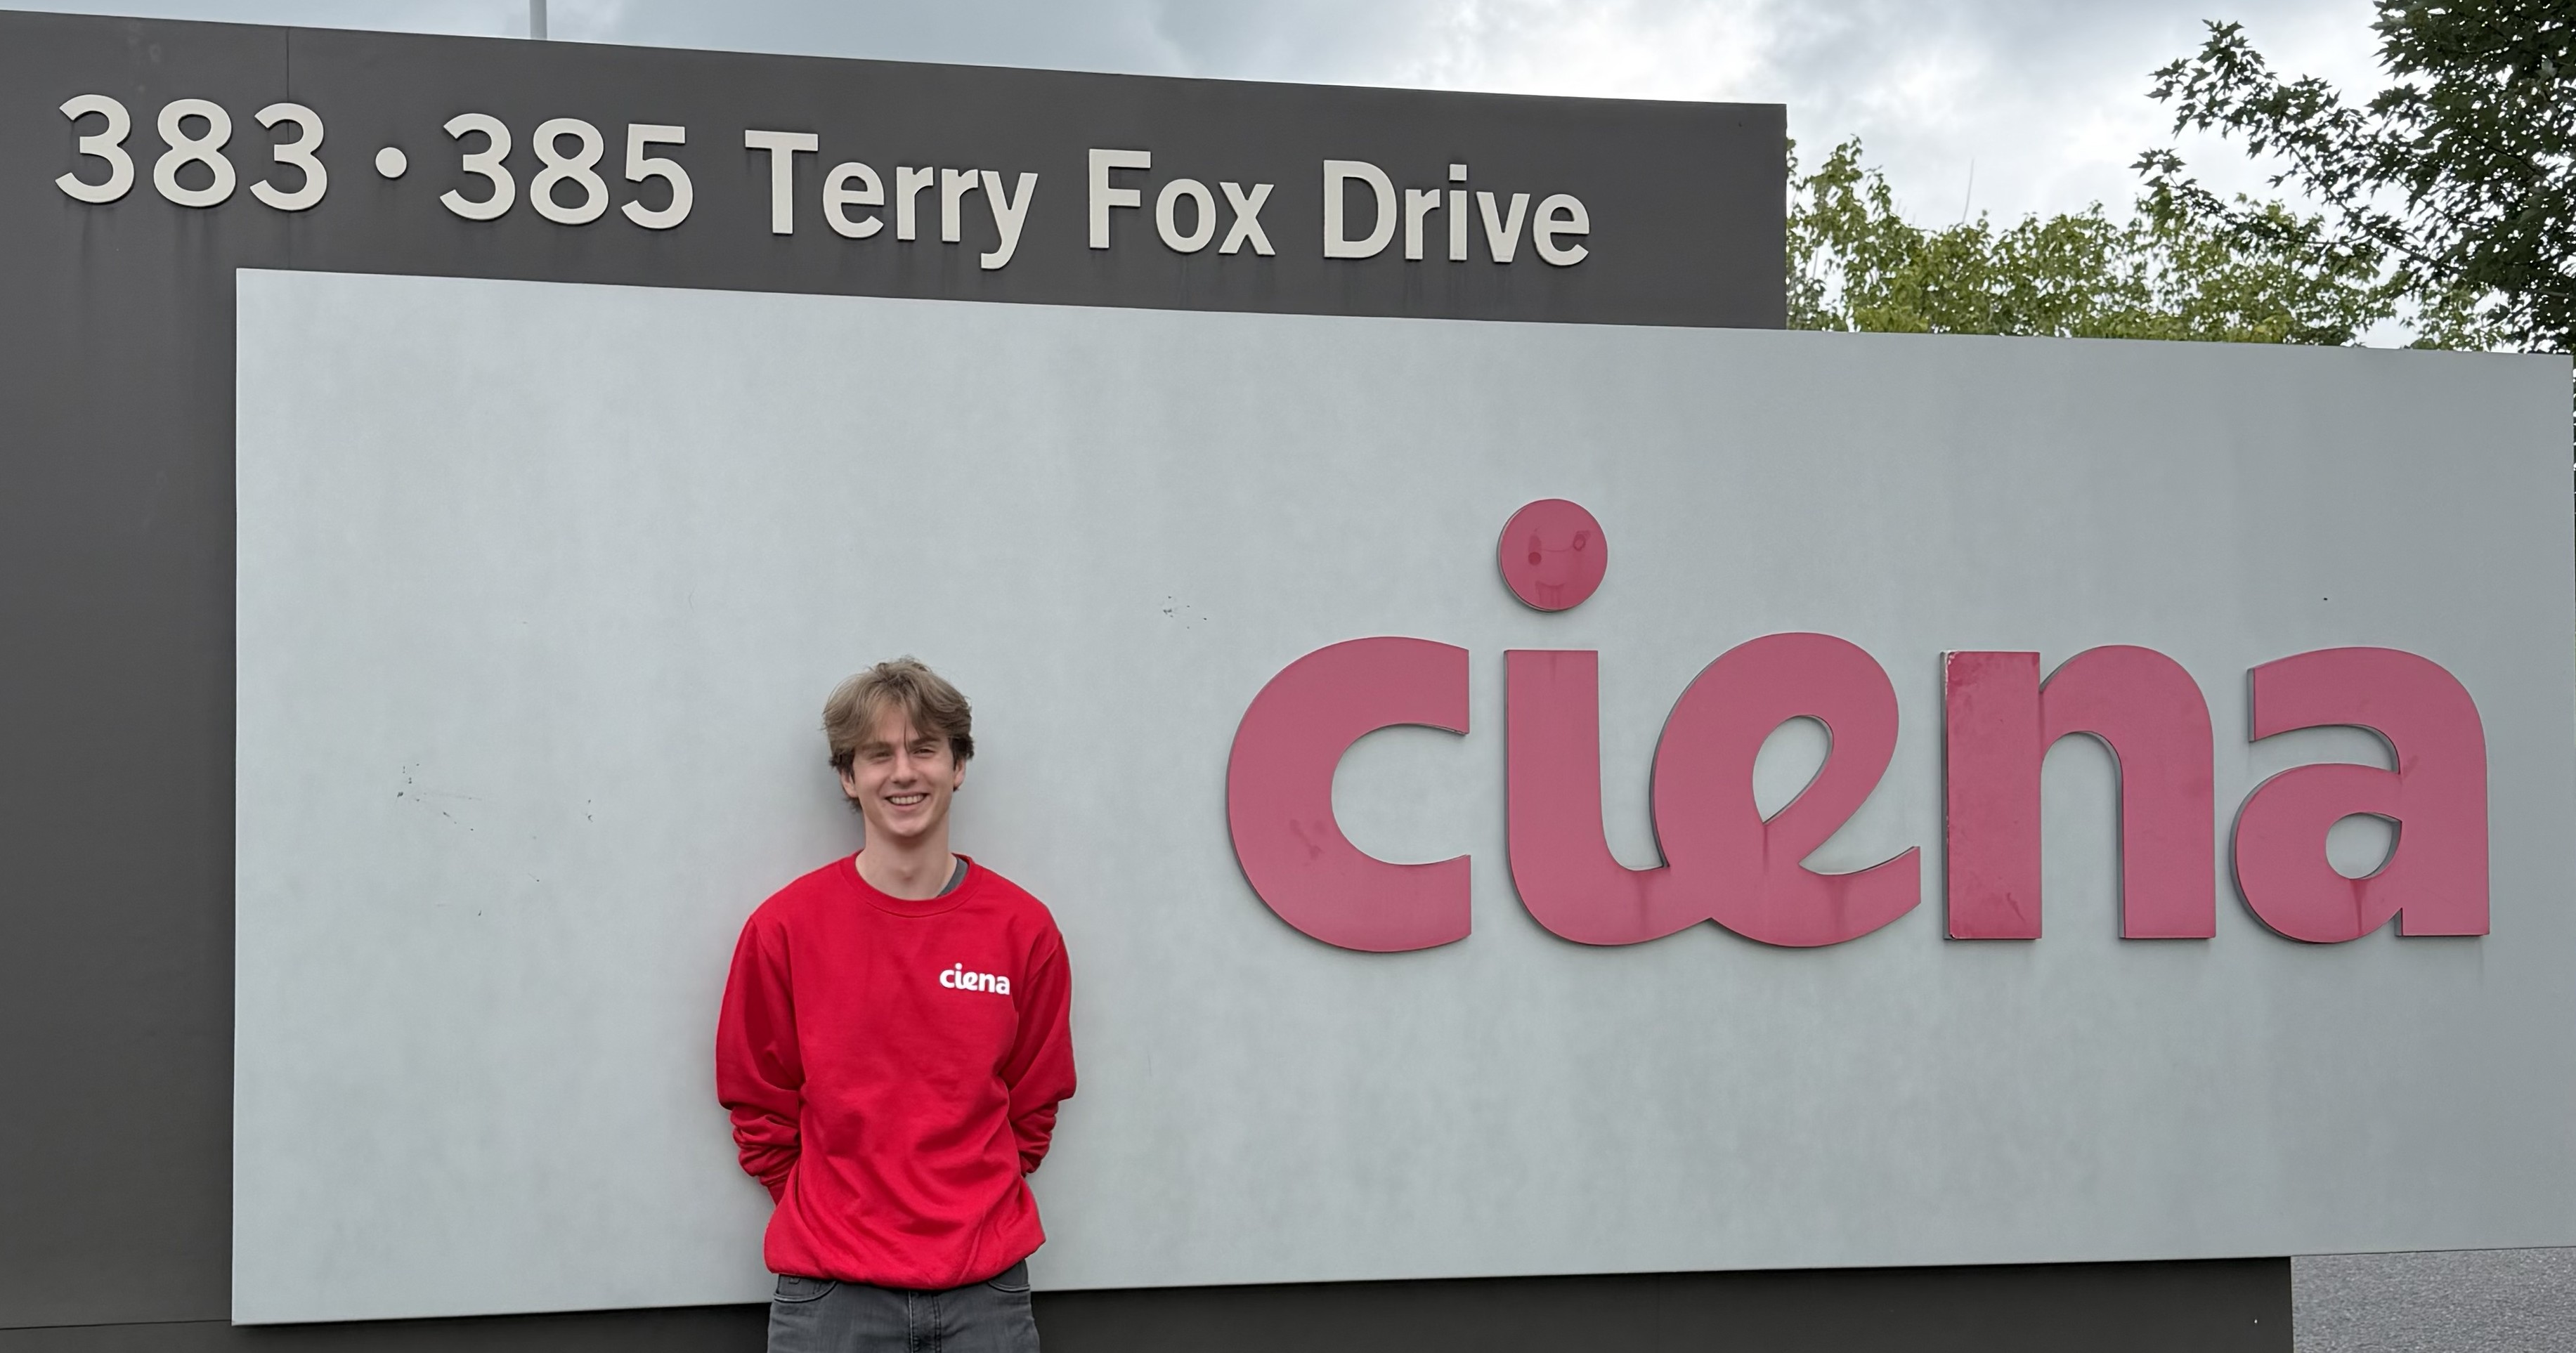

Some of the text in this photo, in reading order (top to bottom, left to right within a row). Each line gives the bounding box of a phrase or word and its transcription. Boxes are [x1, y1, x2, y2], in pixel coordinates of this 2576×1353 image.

[54, 93, 328, 211] 383
[438, 112, 694, 230] 385
[744, 129, 1039, 270] Terry
[1088, 148, 1277, 256] Fox
[1322, 159, 1591, 266] Drive
[1225, 497, 2491, 954] ciena
[939, 962, 1010, 995] ciena
